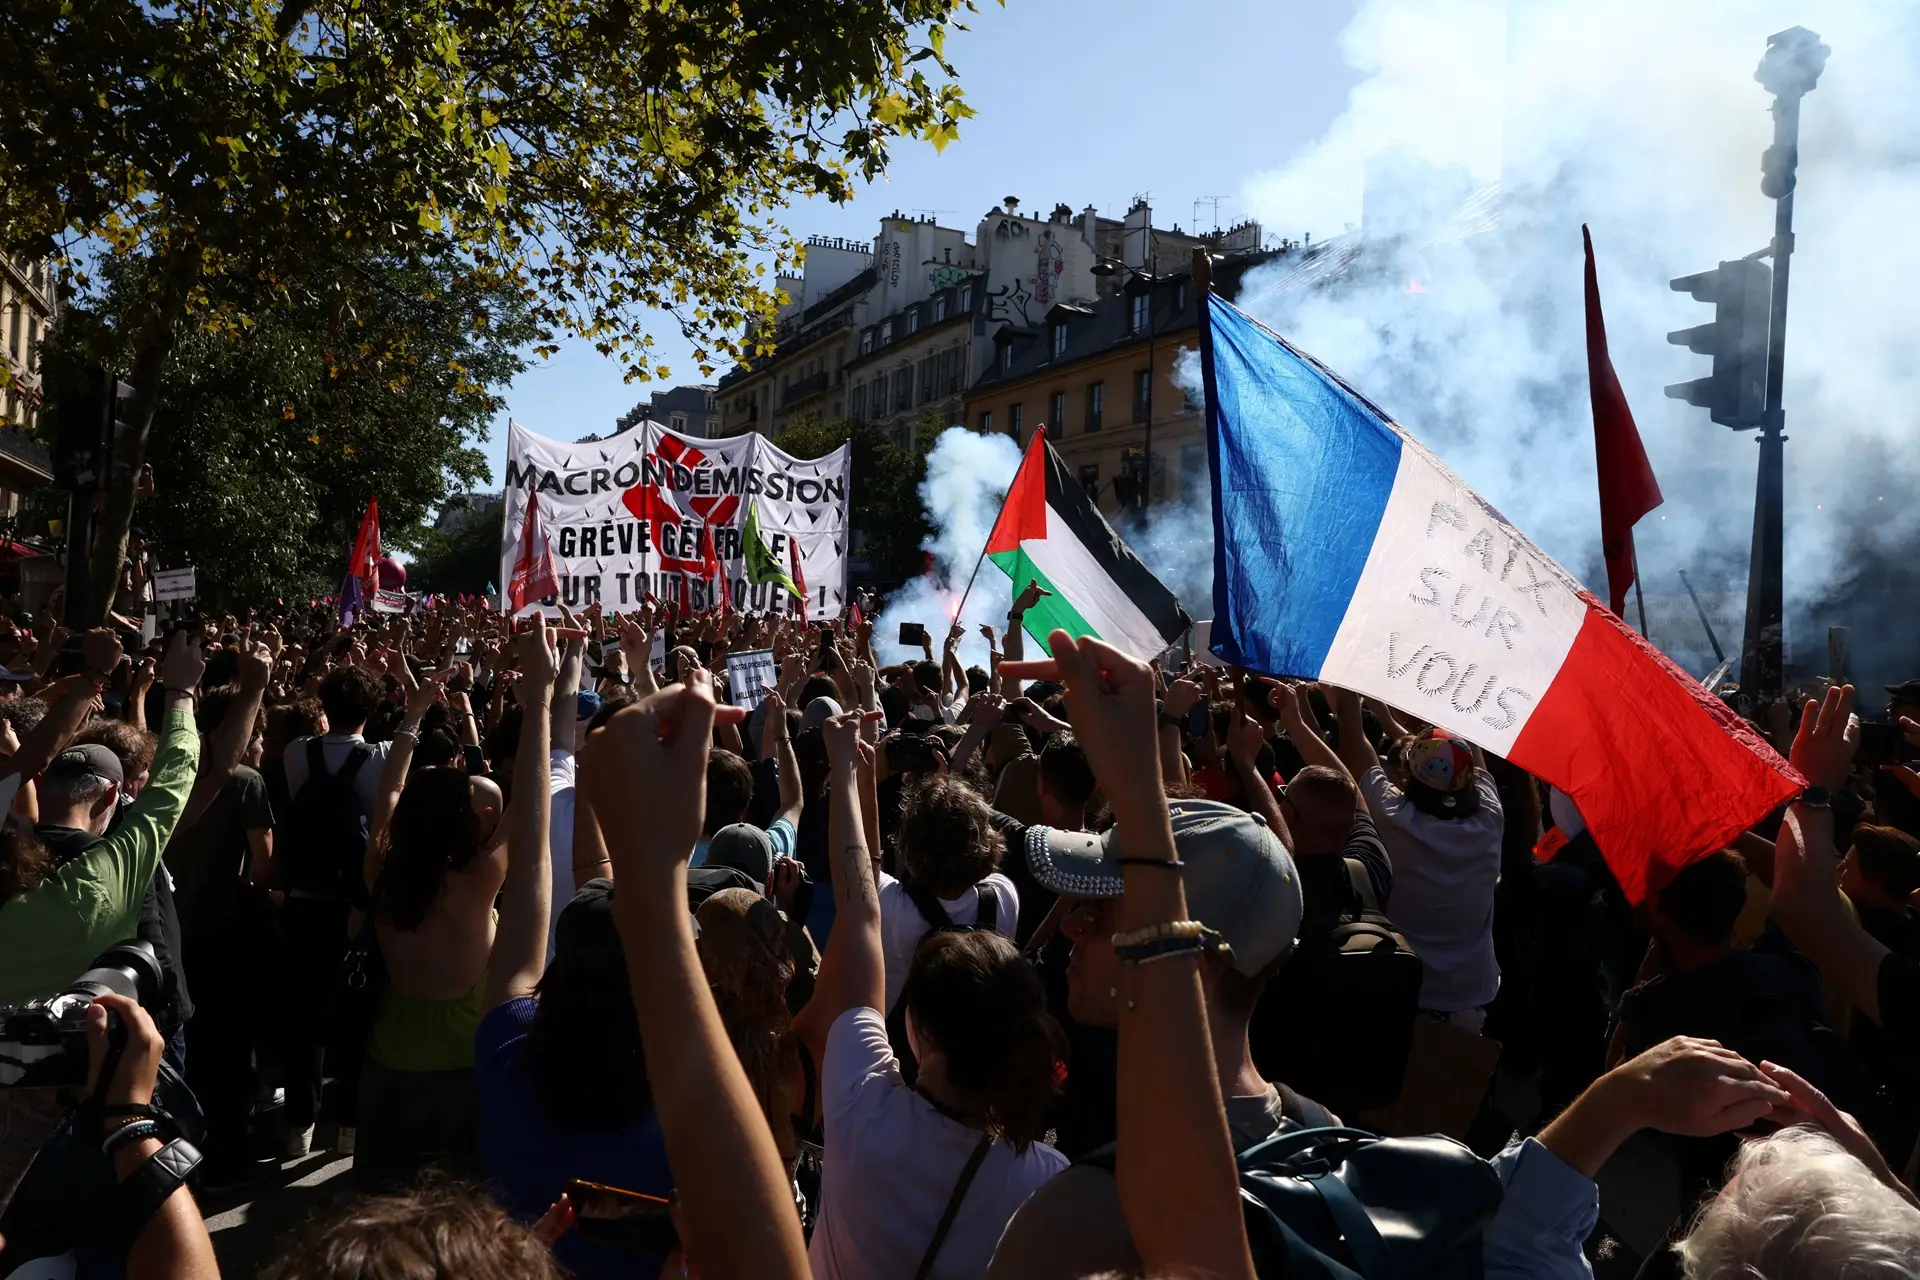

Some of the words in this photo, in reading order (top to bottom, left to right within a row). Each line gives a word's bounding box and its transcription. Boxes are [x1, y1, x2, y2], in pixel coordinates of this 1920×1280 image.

[506, 458, 665, 496] MACRON
[675, 459, 845, 503] DÉMISSION
[559, 520, 652, 557] GRÈVE
[1425, 501, 1557, 617] PAIX
[1408, 566, 1527, 650] SUR
[1387, 631, 1534, 731] VOUS
